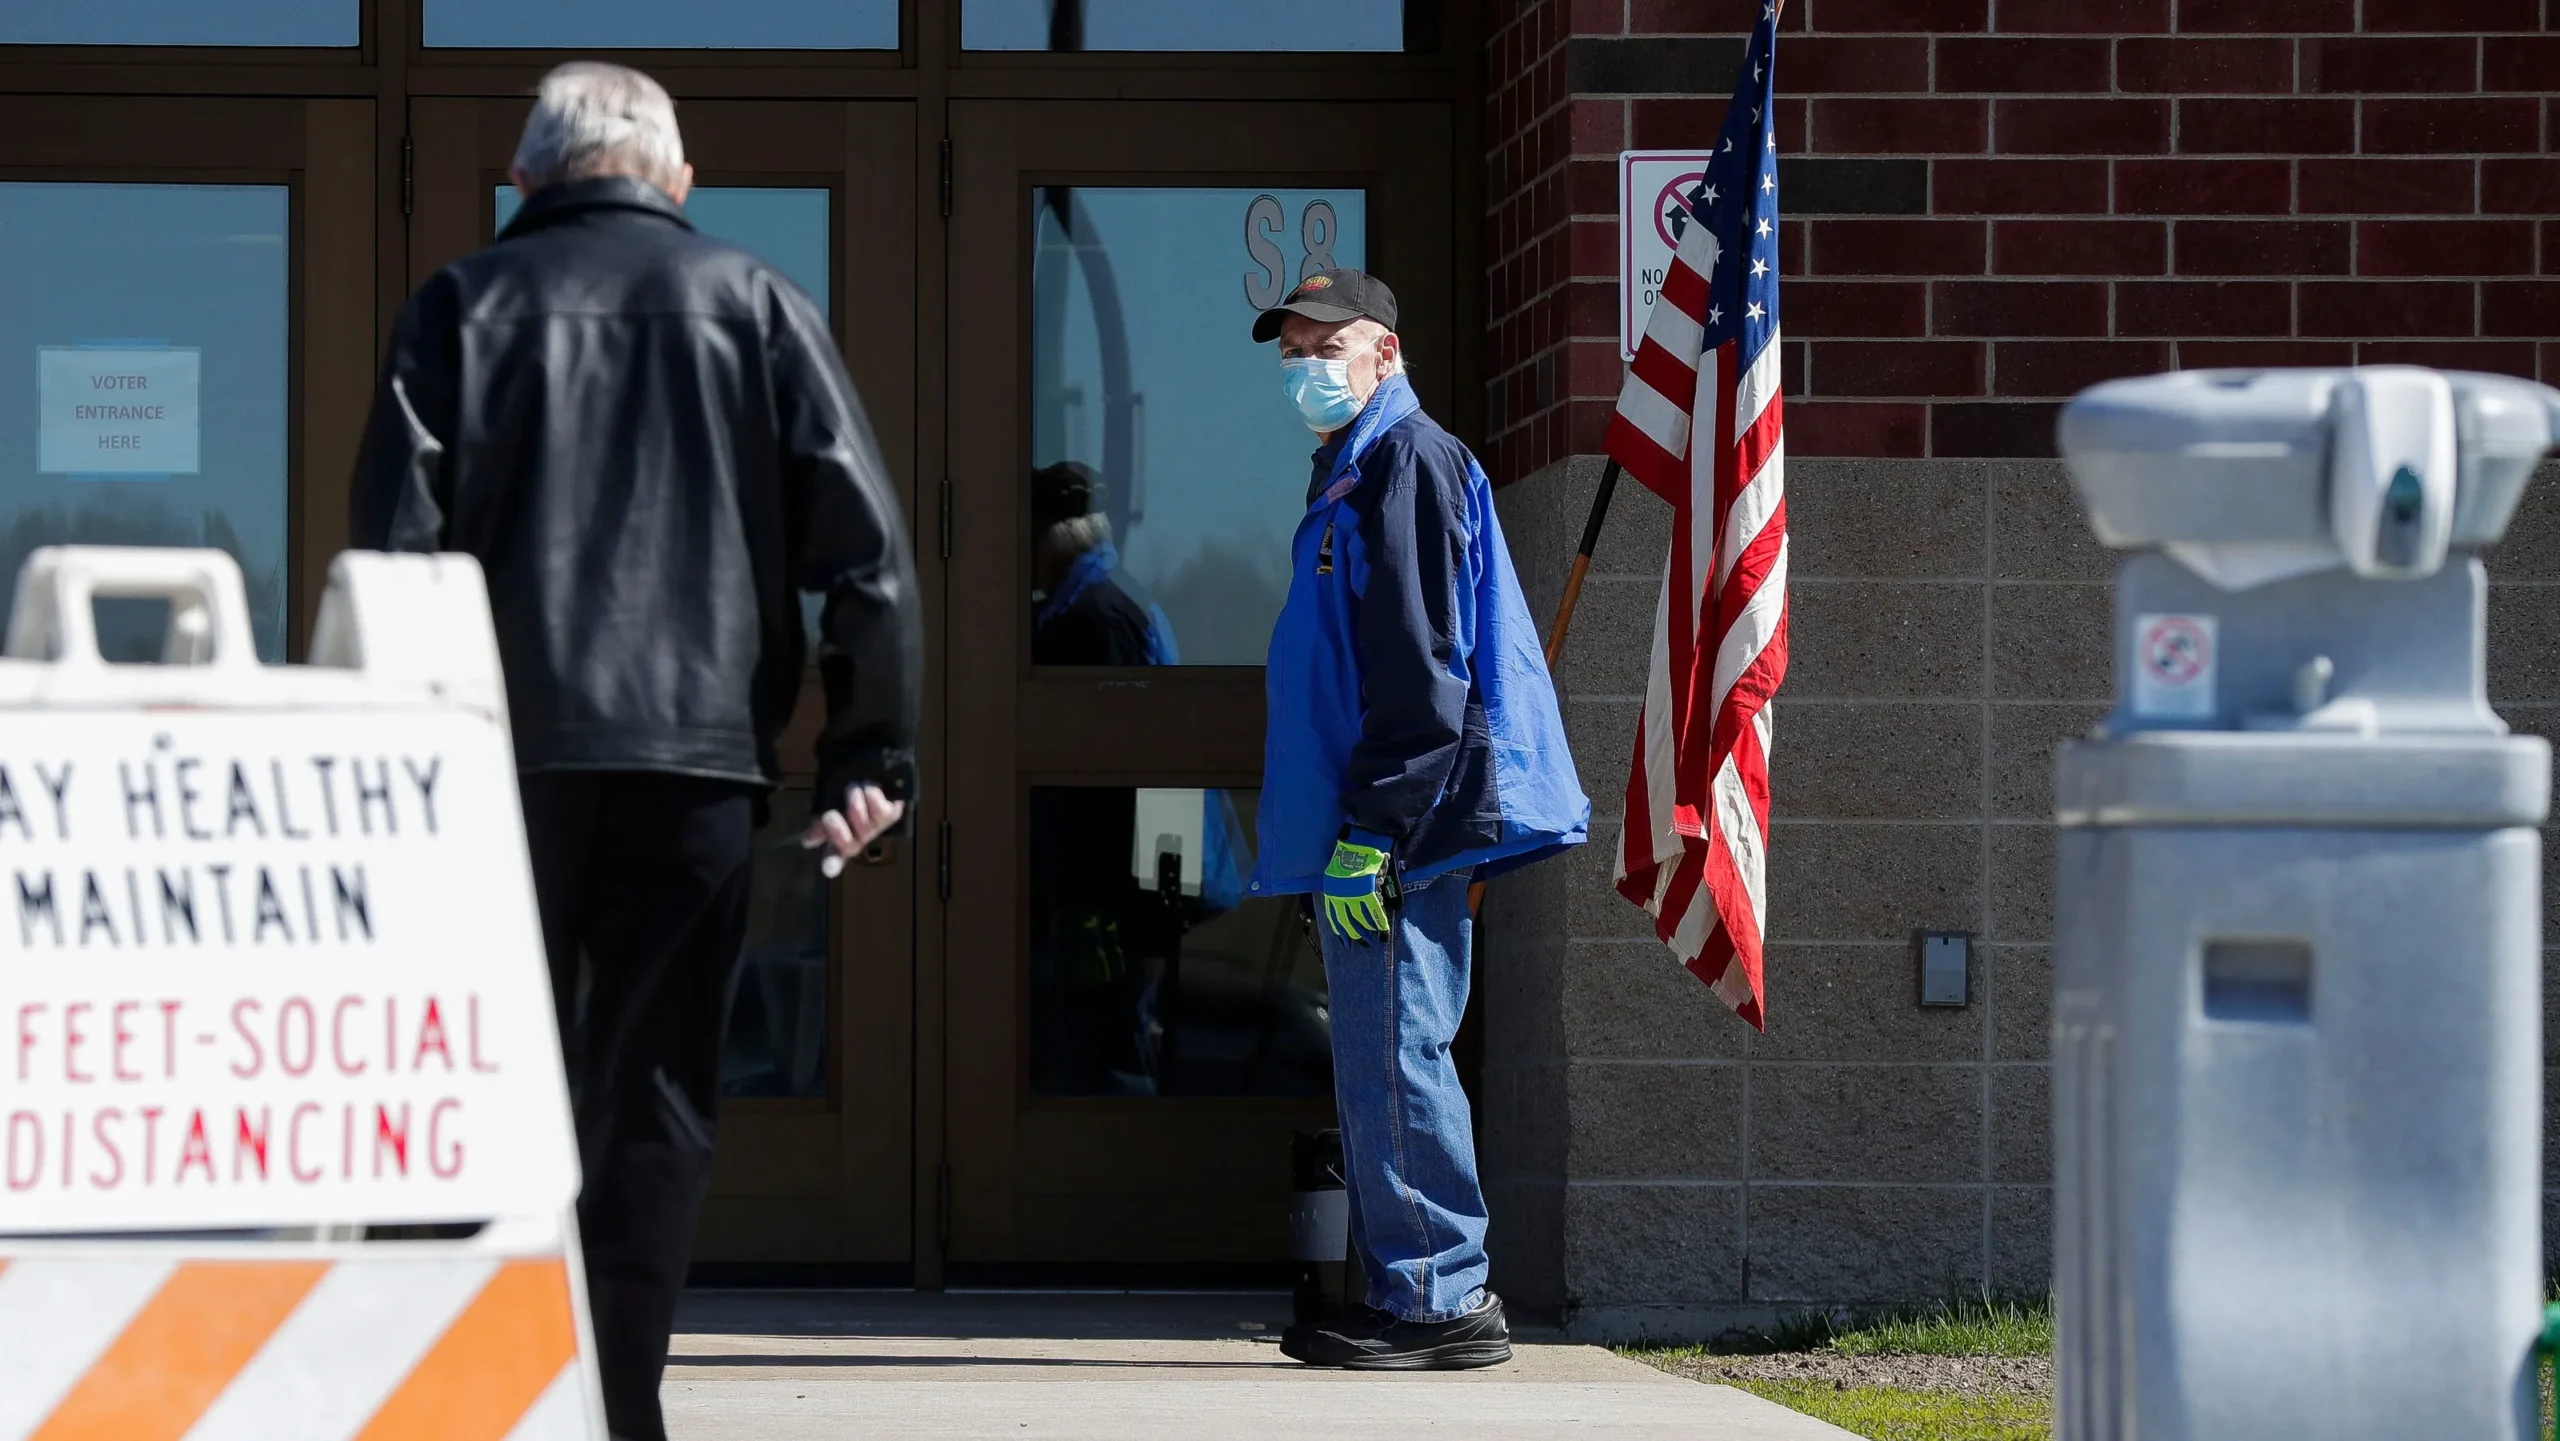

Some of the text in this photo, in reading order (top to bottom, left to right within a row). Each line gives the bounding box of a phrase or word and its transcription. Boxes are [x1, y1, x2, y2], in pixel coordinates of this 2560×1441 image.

[1243, 193, 1338, 311] S8
[1641, 268, 1664, 285] NO
[75, 405, 164, 419] ENTRANCE
[91, 375, 148, 390] VOTER
[98, 435, 141, 449] HERE
[119, 754, 442, 842] HEALTHY
[13, 863, 376, 947] MAINTAIN
[17, 994, 500, 1084] FEET-SOCIAL
[6, 1097, 465, 1192] DISTANCING
